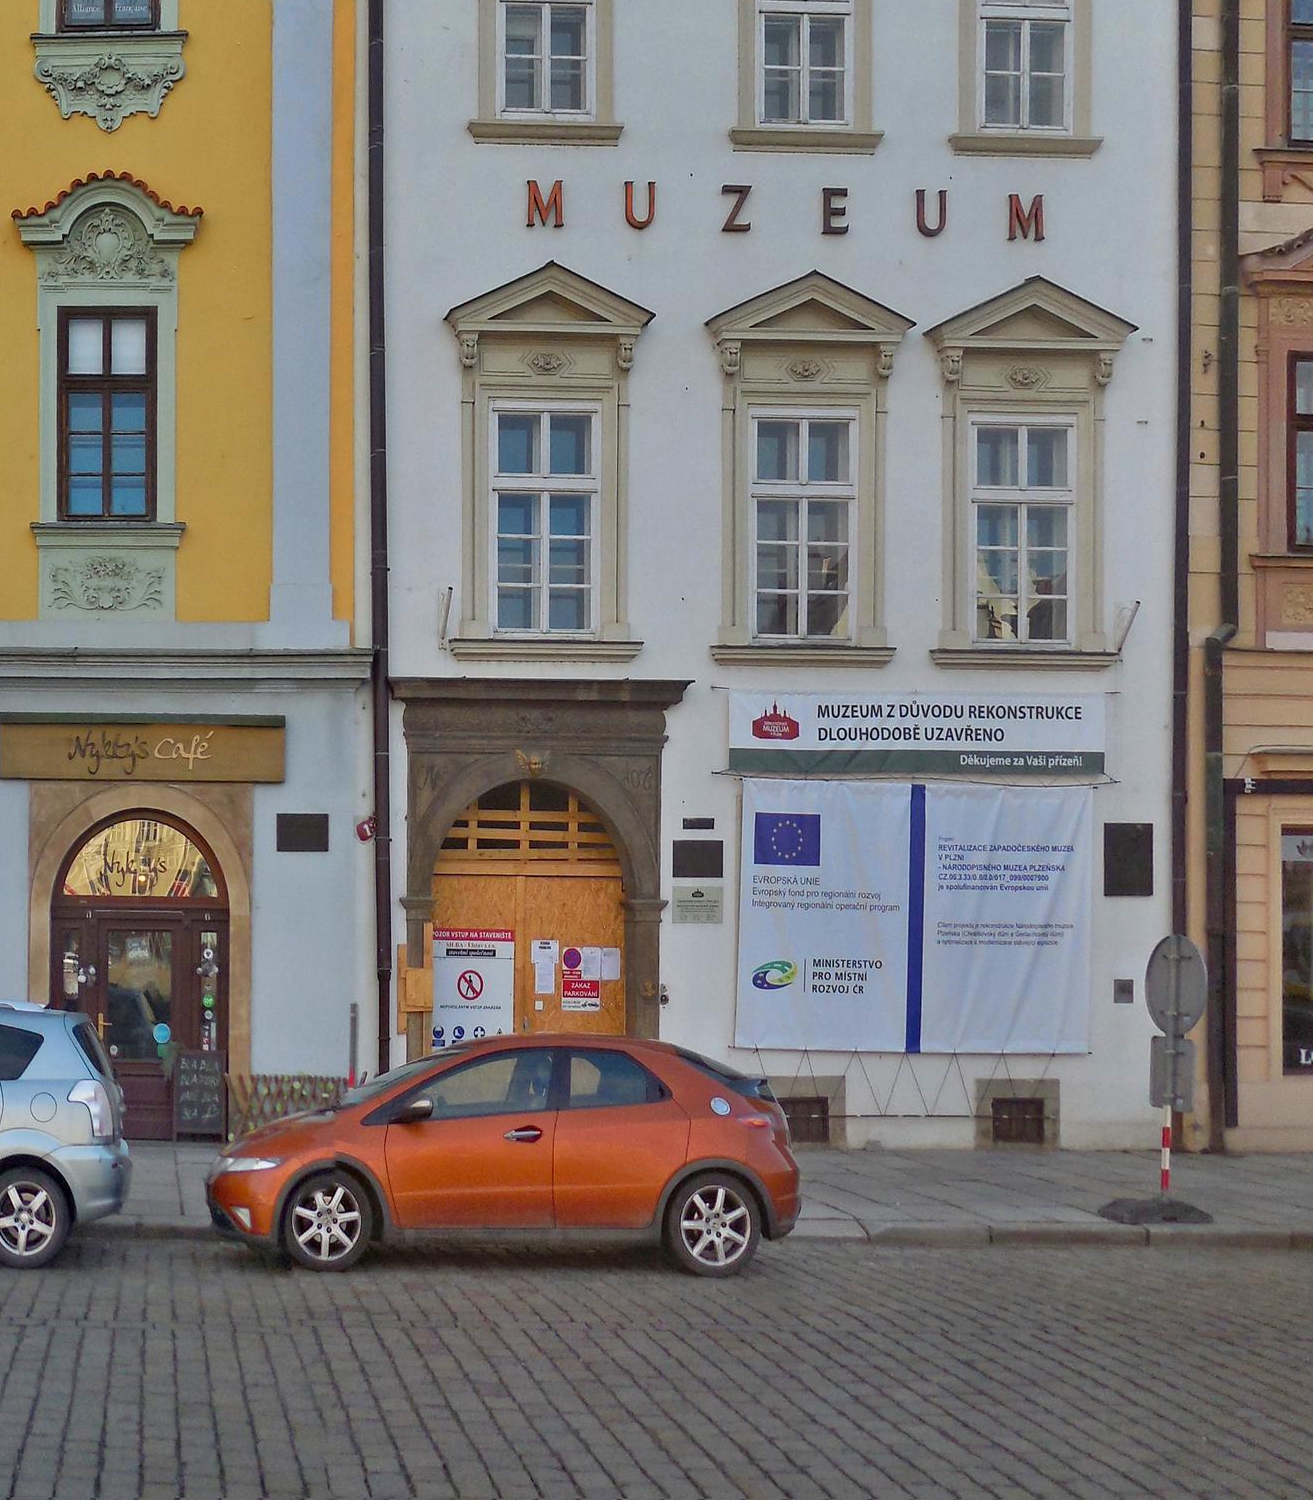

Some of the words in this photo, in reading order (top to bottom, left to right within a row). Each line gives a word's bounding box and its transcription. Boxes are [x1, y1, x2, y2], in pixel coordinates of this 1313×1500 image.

[526, 180, 1046, 241] MUZEUM
[817, 704, 883, 719] MUZEUM
[887, 704, 896, 718] Z
[899, 700, 964, 719] DŮVODU
[968, 705, 1082, 720] REKONSTRUKCE
[818, 724, 920, 741] DLOUHODOBĚ
[924, 724, 1005, 742] UZAVŘENO
[154, 730, 214, 771] Café
[959, 754, 1011, 768] Děkujeme
[1013, 758, 1024, 766] za
[1026, 755, 1046, 766] Vaší
[1048, 756, 1083, 768] přízeň!
[938, 844, 988, 852] REVITALIZACE
[1051, 844, 1074, 853] MUZEA
[938, 853, 943, 861] V
[944, 853, 965, 861] PLZNI
[752, 875, 799, 886] EVROPSKÁ
[800, 877, 820, 886] UNIE
[938, 883, 944, 891] je
[752, 887, 787, 897] Evropský
[788, 888, 805, 897] fond
[806, 891, 819, 899] pro
[821, 889, 856, 900] regionální
[857, 892, 882, 901] rozvoj
[752, 898, 795, 910] Integrovaný
[797, 901, 834, 911] regionální
[835, 902, 867, 912] operační
[869, 904, 900, 913] program
[479, 931, 512, 939] STAVENIŠTĚ
[812, 959, 883, 970] MINISTERSTVO
[812, 972, 832, 981] PRO
[834, 971, 868, 982] MÍSTNÍ
[571, 981, 591, 989] ZÁKAZ
[812, 984, 849, 994] ROZVOJ
[852, 983, 864, 994] ČR
